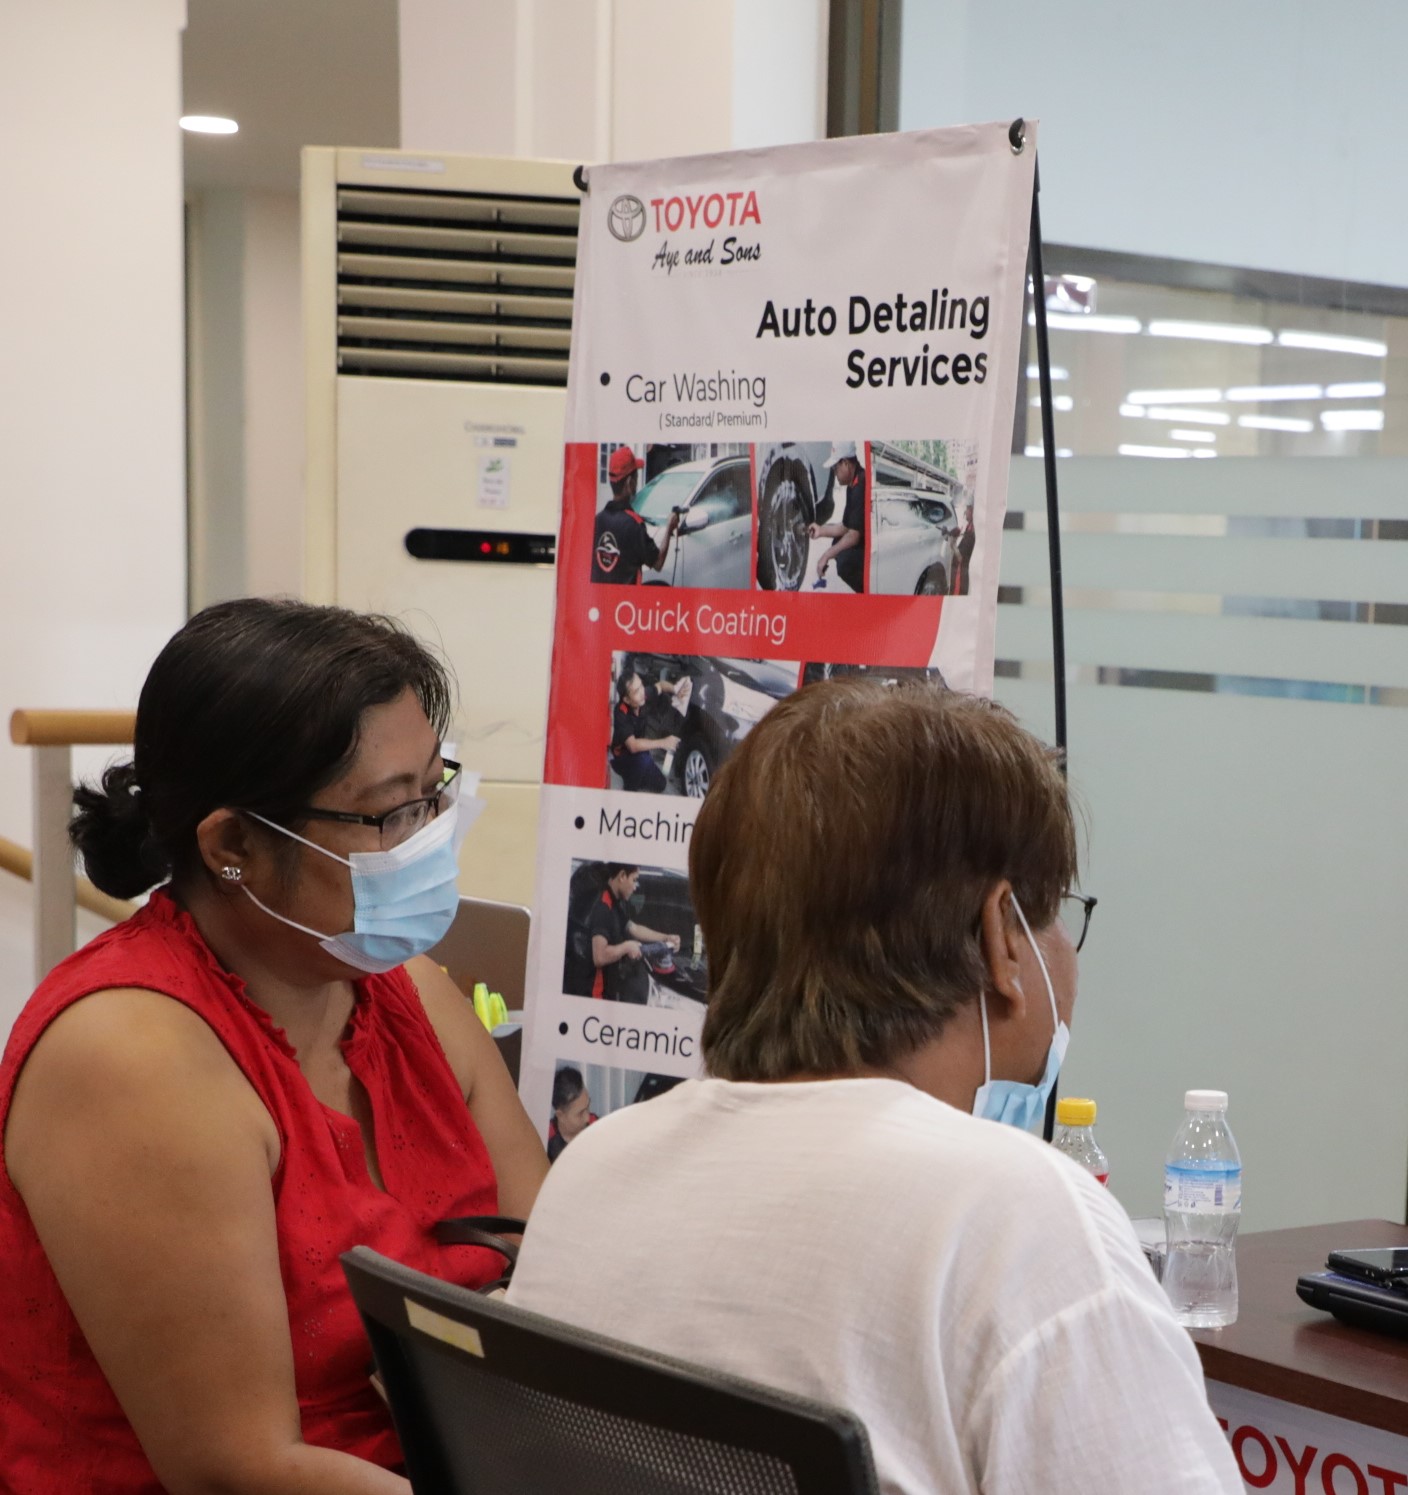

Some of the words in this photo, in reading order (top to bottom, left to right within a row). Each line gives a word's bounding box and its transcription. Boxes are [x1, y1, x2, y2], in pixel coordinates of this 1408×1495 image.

[650, 190, 762, 233] TOYOTA
[652, 239, 680, 276] Aye
[684, 238, 715, 266] and
[720, 236, 762, 266] Sons
[755, 298, 837, 338] Auto
[848, 287, 990, 340] Detaling
[845, 343, 988, 389] Services
[626, 374, 667, 403] Car
[673, 369, 767, 408] Washing
[614, 600, 690, 636] Quick
[696, 604, 787, 646] Coating
[582, 1015, 695, 1058] Ceramic
